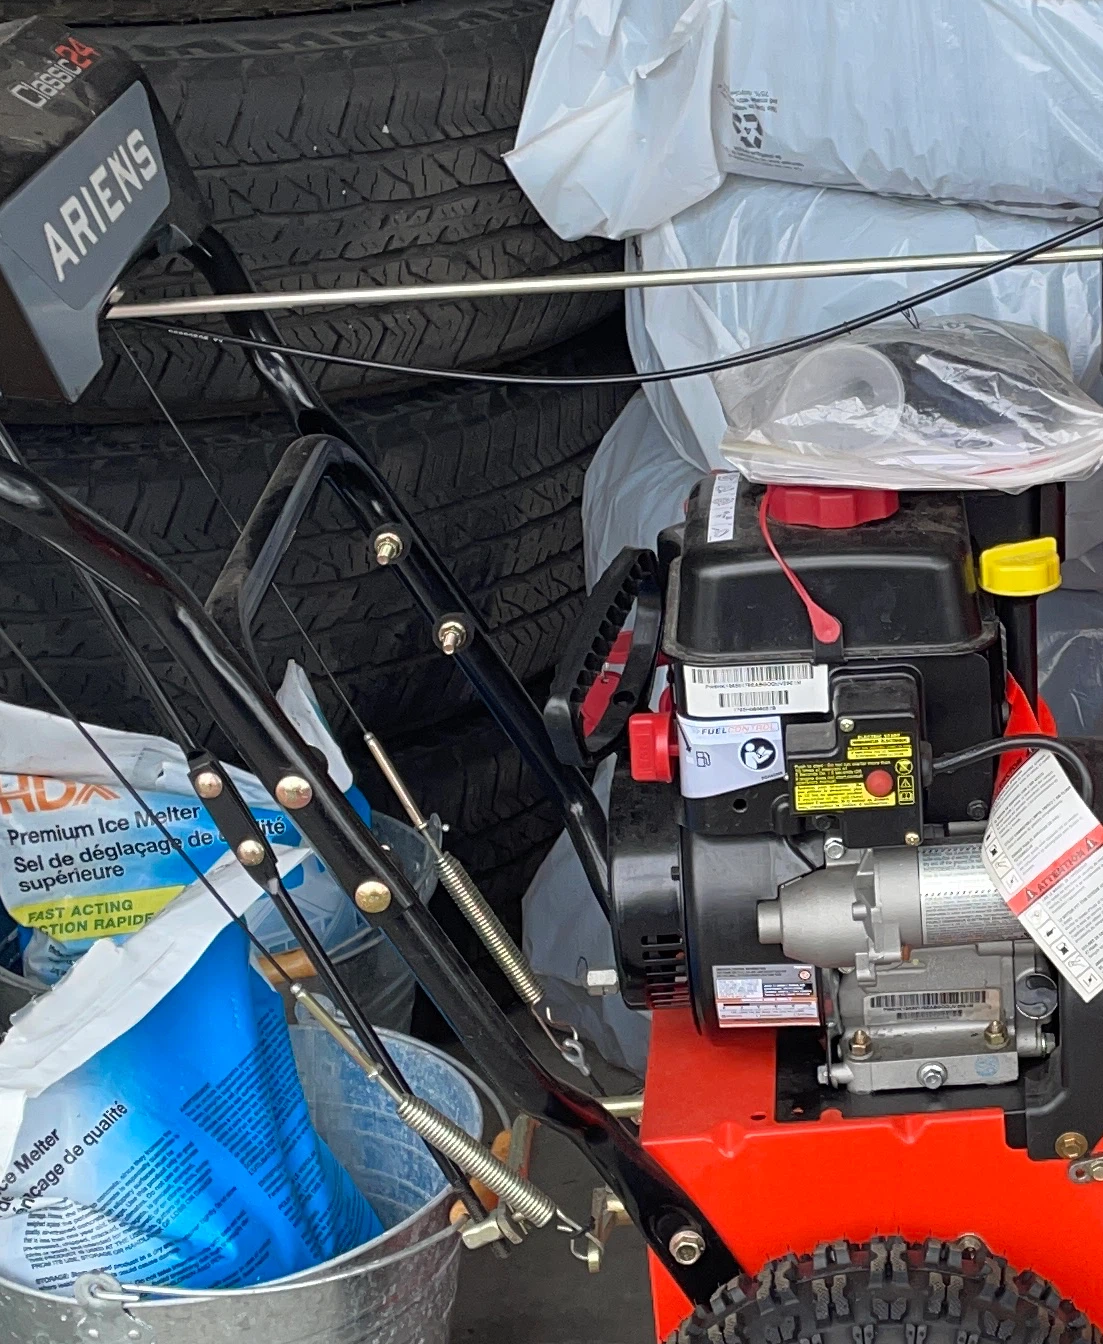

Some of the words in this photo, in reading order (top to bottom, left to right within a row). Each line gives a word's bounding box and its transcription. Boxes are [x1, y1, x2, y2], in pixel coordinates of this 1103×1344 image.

[44, 129, 158, 283] ARIENS
[8, 824, 94, 847] Premium
[100, 817, 130, 834] Ice
[135, 806, 201, 829] Melter
[14, 856, 44, 874] Sel
[48, 852, 74, 870] de
[79, 837, 182, 864] déglaçage
[188, 829, 213, 847] de
[1037, 851, 1087, 893] ATTENTION
[18, 862, 125, 893] supérieure
[27, 907, 65, 923] FAST
[71, 899, 133, 917] ACTING
[40, 921, 87, 936] CTION
[63, 1144, 85, 1165] de
[83, 1100, 128, 1147] qualité
[0, 1172, 17, 1194] ce
[14, 1128, 60, 1174] Melter
